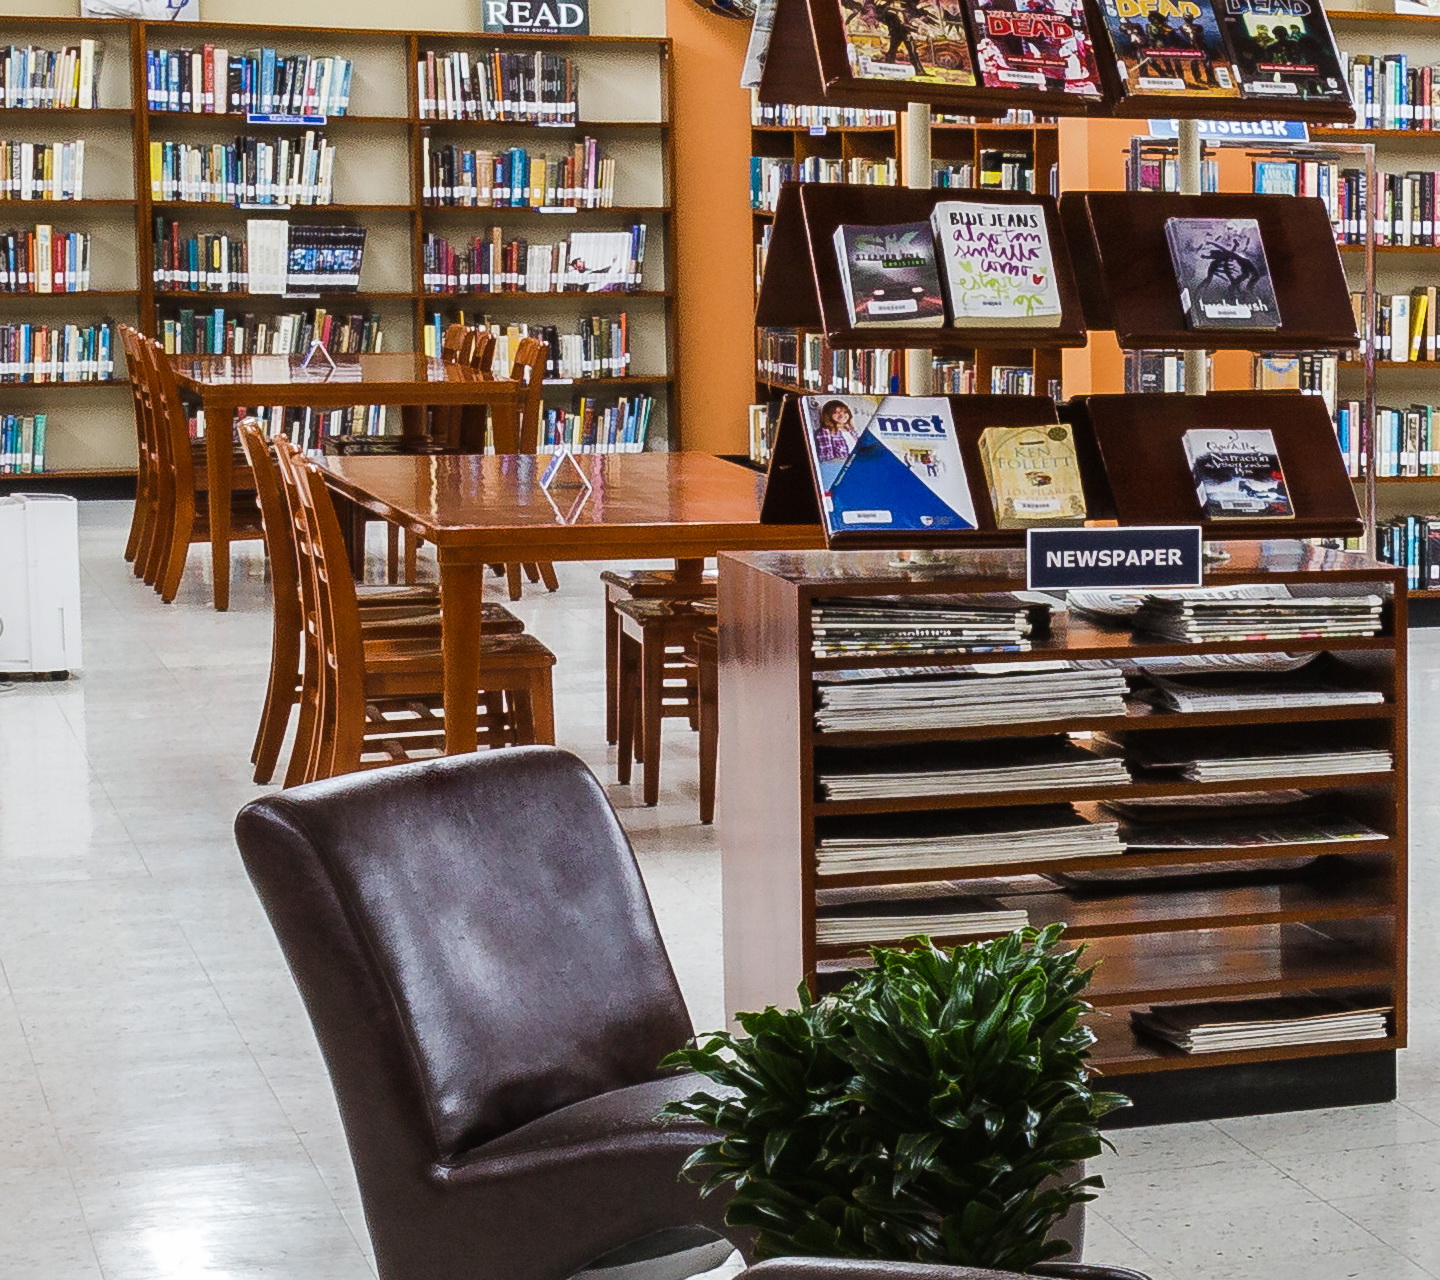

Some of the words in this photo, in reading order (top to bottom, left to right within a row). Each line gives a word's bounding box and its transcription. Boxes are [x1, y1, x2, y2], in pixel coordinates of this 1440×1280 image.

[486, 1, 584, 28] READ
[987, 16, 1074, 40] DEAD
[950, 212, 985, 227] BLUE
[989, 213, 1039, 228] JEANS
[953, 222, 1001, 253] algo
[877, 414, 946, 434] met
[1014, 446, 1050, 457] KEN
[998, 457, 1072, 469] FOLLETT
[1046, 549, 1183, 568] NEWSPAPER
